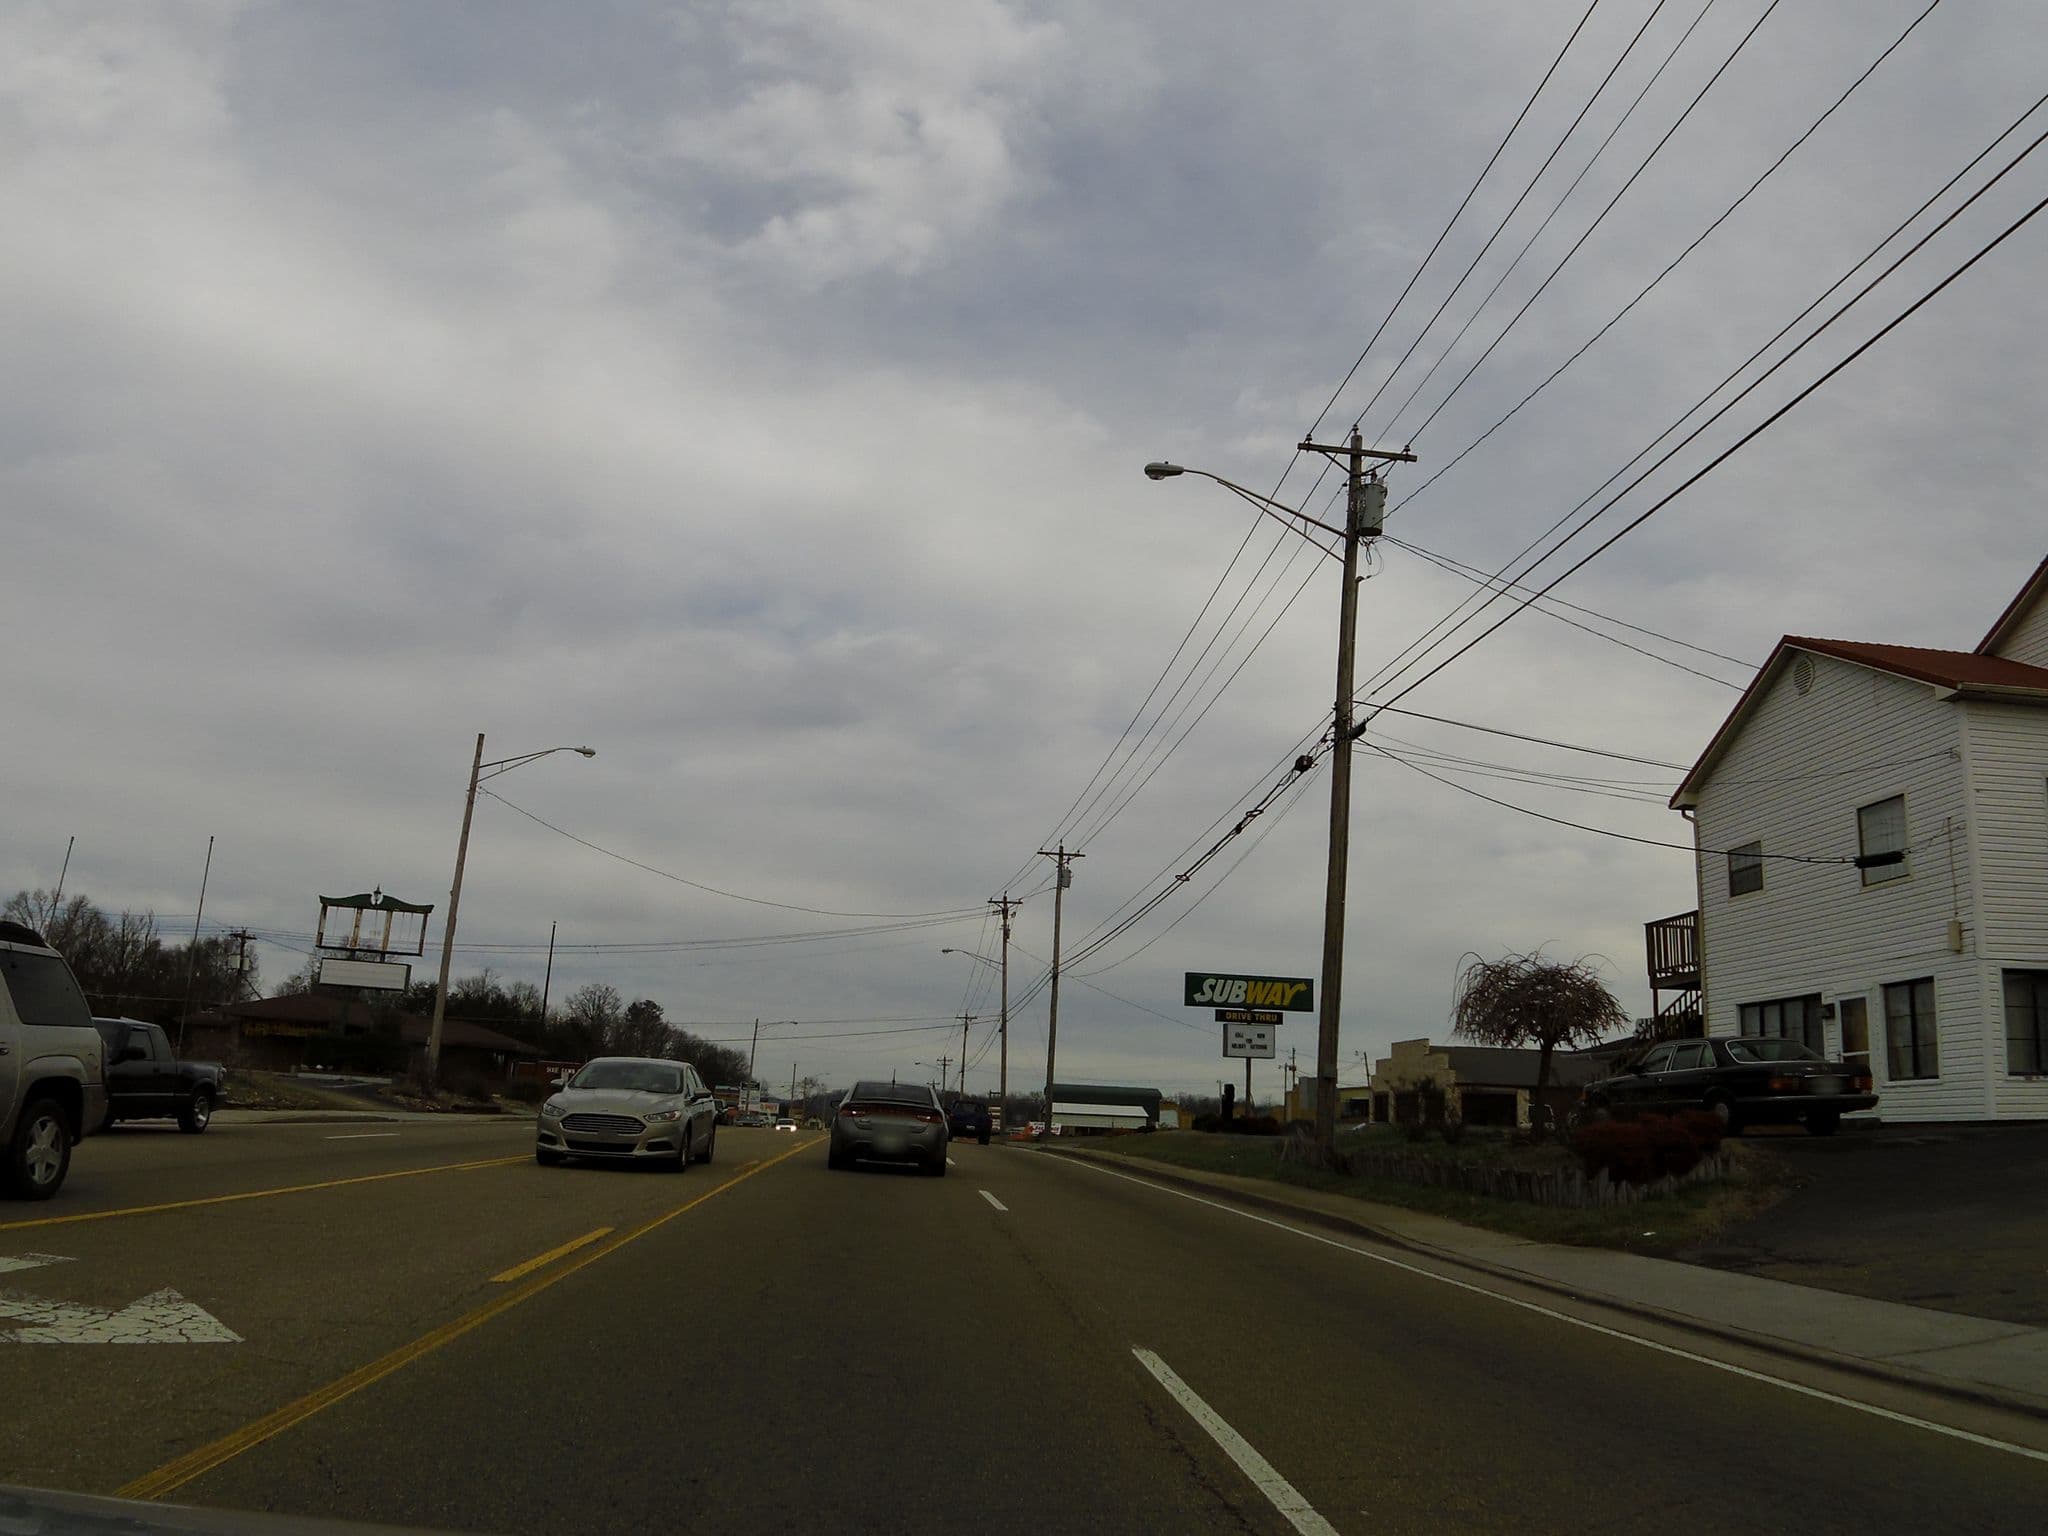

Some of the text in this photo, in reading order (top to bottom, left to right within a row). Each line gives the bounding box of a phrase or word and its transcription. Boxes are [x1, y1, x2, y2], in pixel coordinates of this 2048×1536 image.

[1193, 978, 1307, 1006] SUBWAY
[1225, 1011, 1278, 1022] DRIVE THRU
